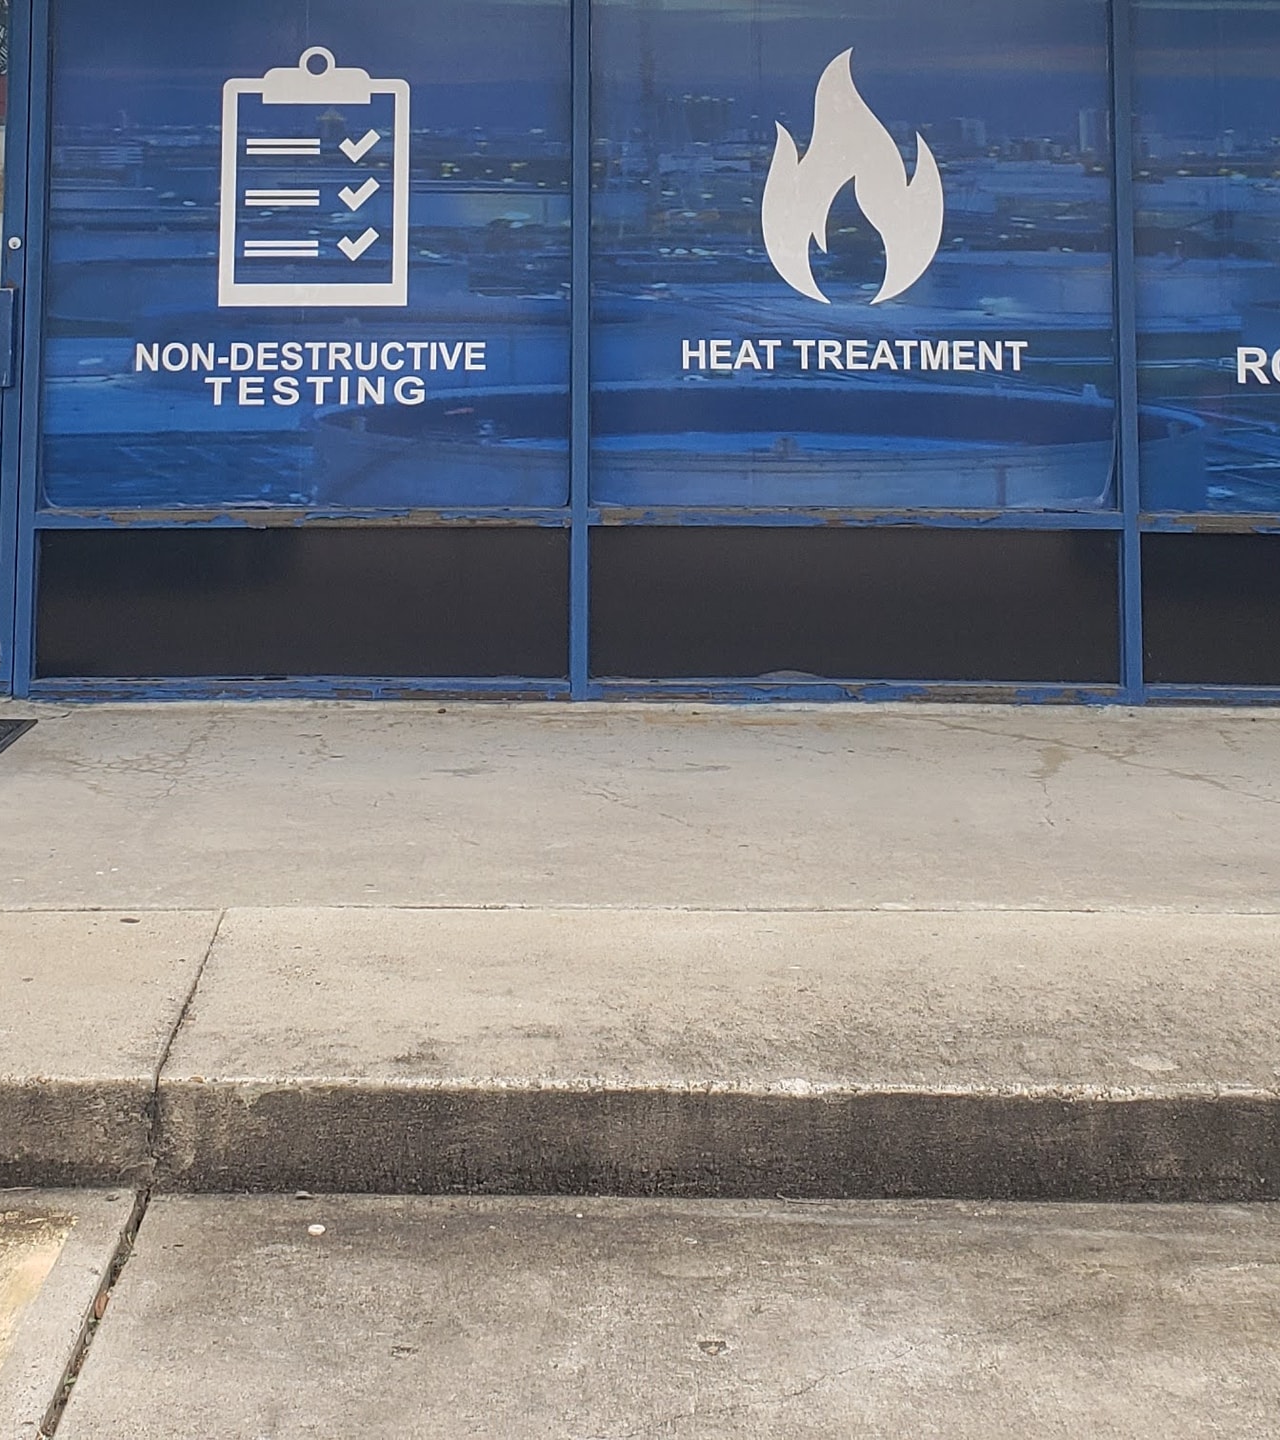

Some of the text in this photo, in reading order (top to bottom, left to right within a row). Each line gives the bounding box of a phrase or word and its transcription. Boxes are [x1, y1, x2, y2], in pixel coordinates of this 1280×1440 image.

[134, 341, 487, 372] NON-DESTRUCTIVE
[681, 339, 1028, 371] HEAT TREATMENT
[204, 375, 427, 406] TESTING
